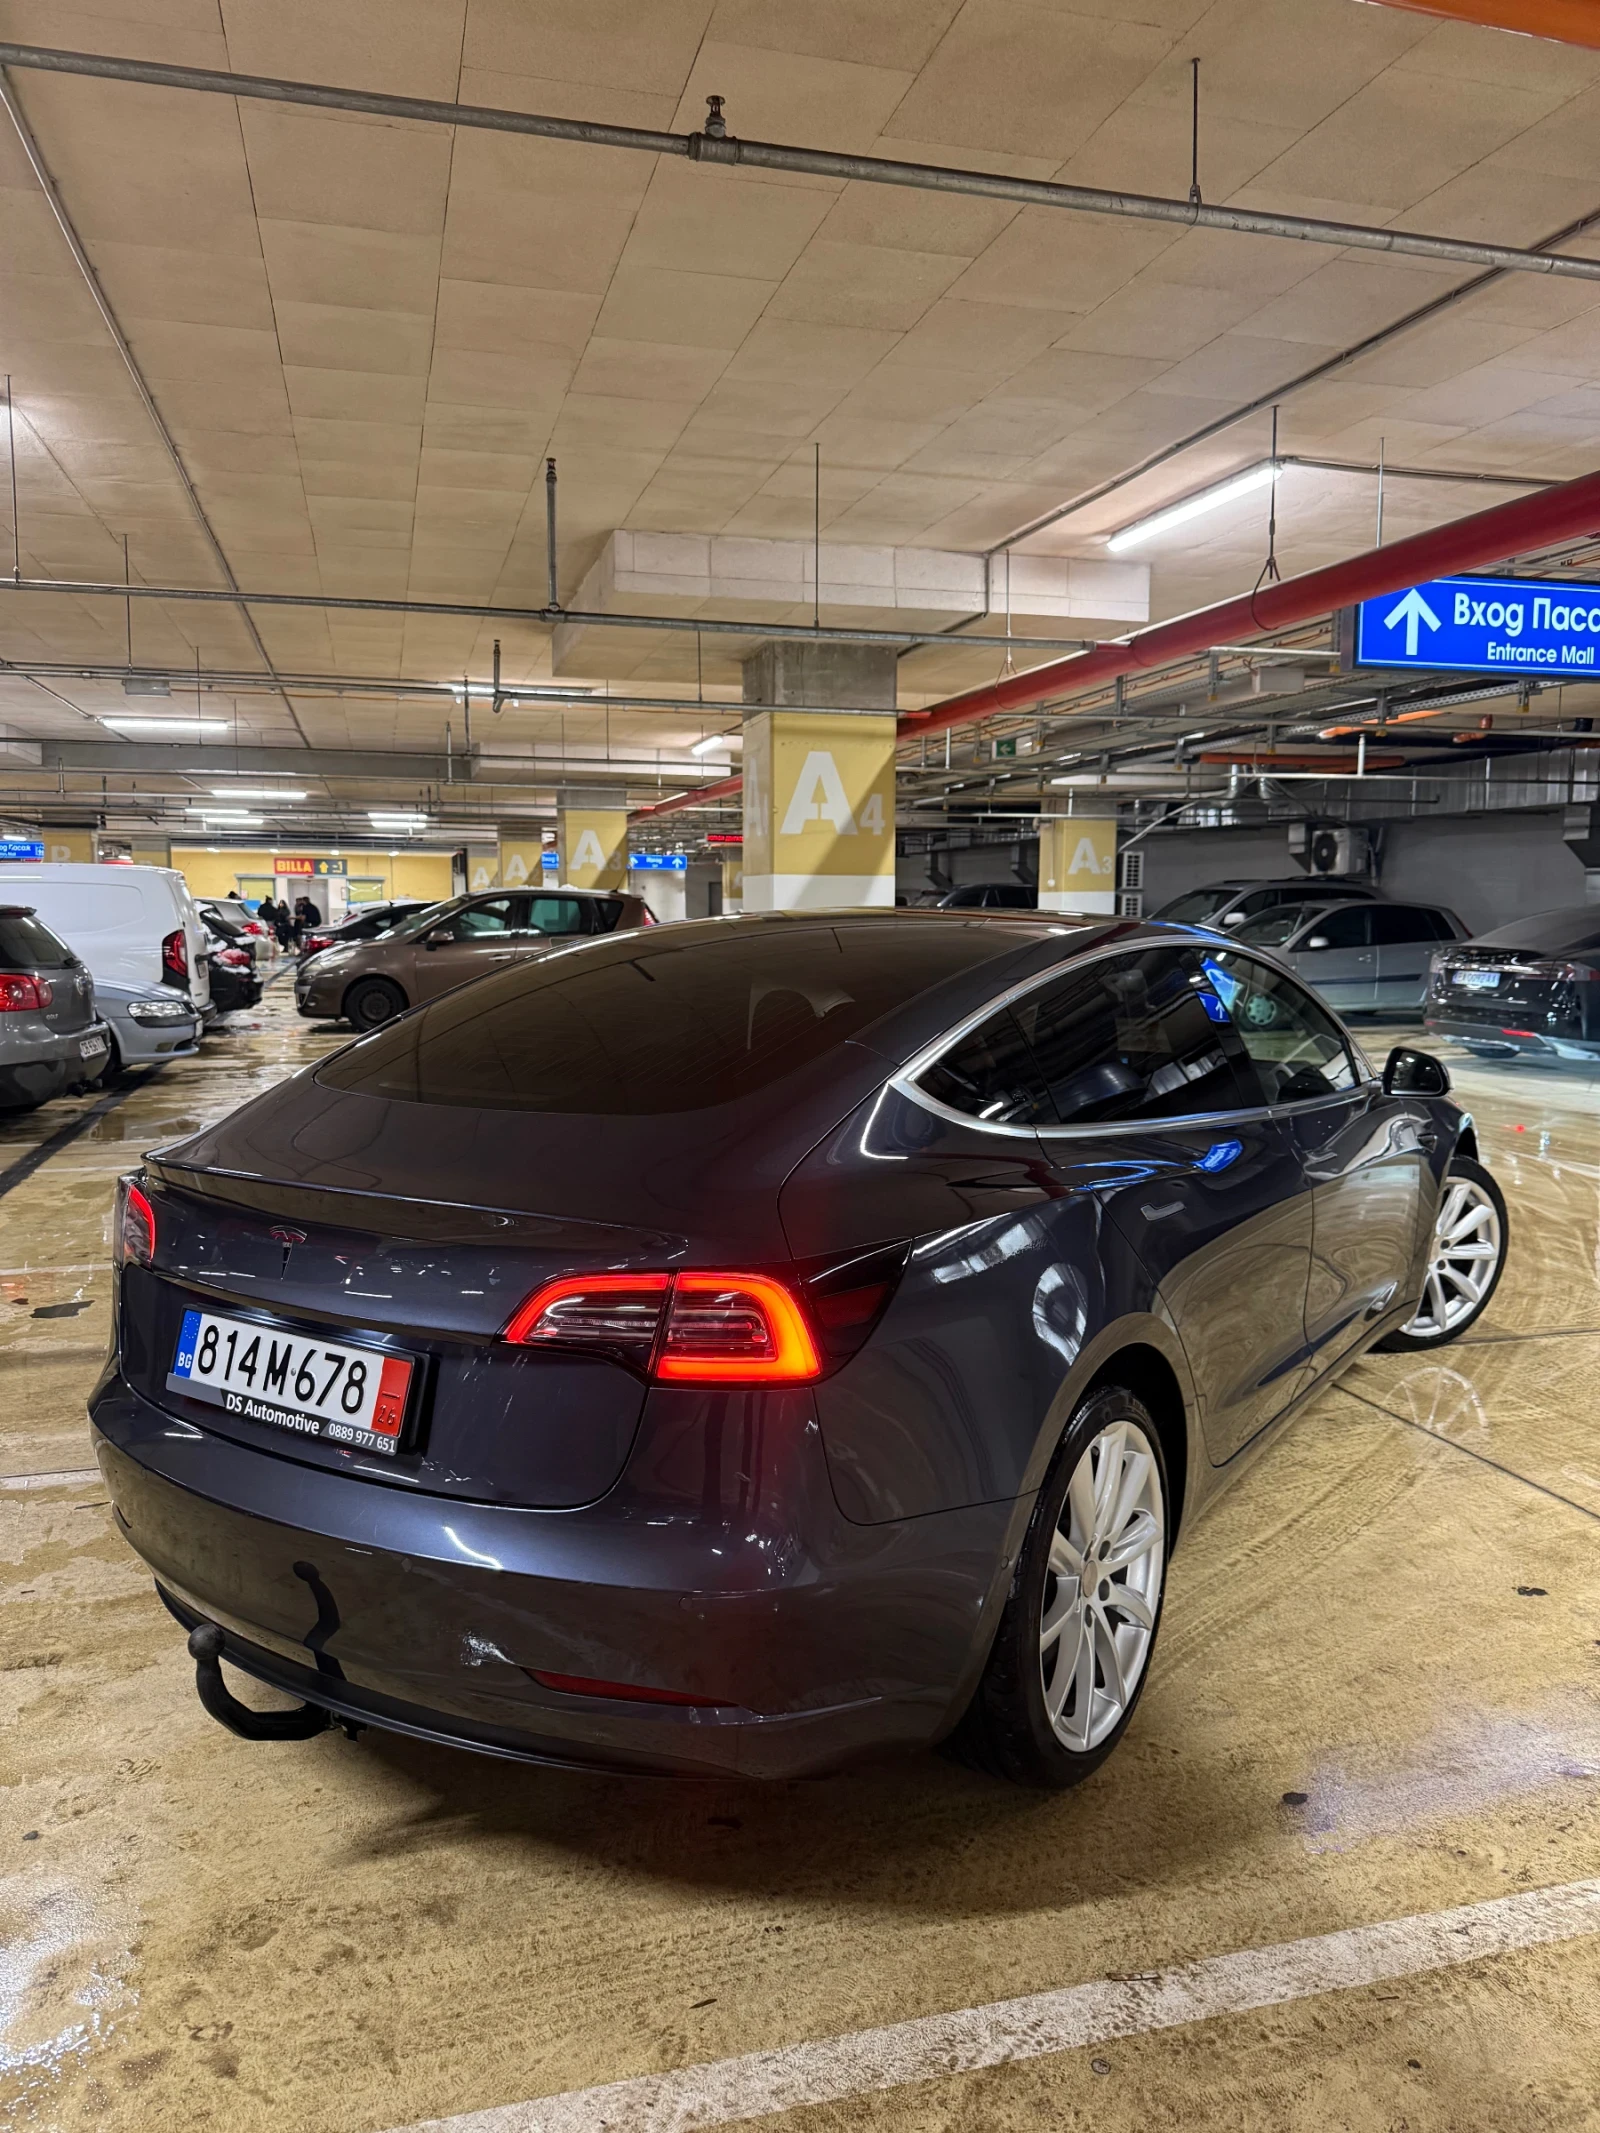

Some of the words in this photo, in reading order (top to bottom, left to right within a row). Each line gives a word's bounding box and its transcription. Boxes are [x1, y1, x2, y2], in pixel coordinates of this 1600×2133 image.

[1454, 592, 1524, 637] Вход
[1486, 641, 1557, 663] Entrance
[1561, 645, 1595, 665] Mall
[276, 860, 312, 872] BILLA
[177, 1352, 193, 1369] BG
[226, 1393, 243, 1412] DS
[244, 1399, 320, 1435] Automotive
[328, 1423, 354, 1440] 0889
[355, 1431, 376, 1446] 977
[376, 1436, 396, 1453] 651
